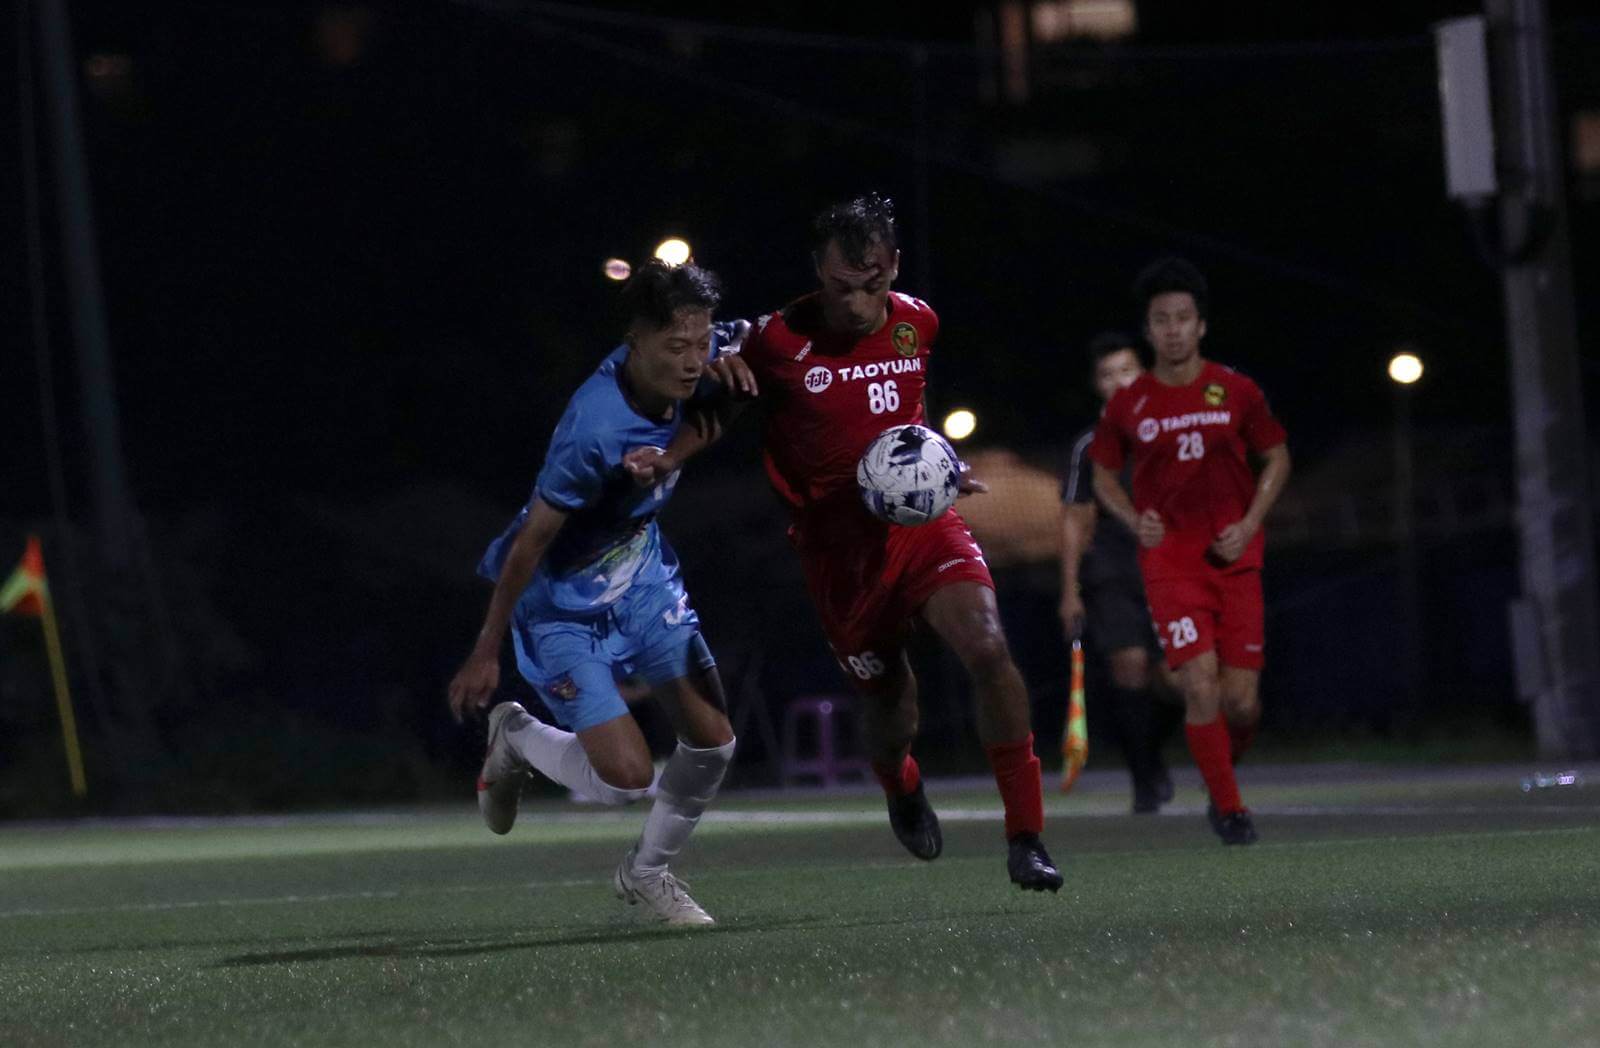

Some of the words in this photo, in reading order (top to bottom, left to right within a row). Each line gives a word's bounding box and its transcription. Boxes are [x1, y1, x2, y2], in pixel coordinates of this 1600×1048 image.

[838, 357, 921, 382] TAOYUAN
[867, 380, 900, 415] 86
[1176, 431, 1205, 462] 28
[1167, 616, 1199, 650] 28
[848, 651, 885, 681] 86
